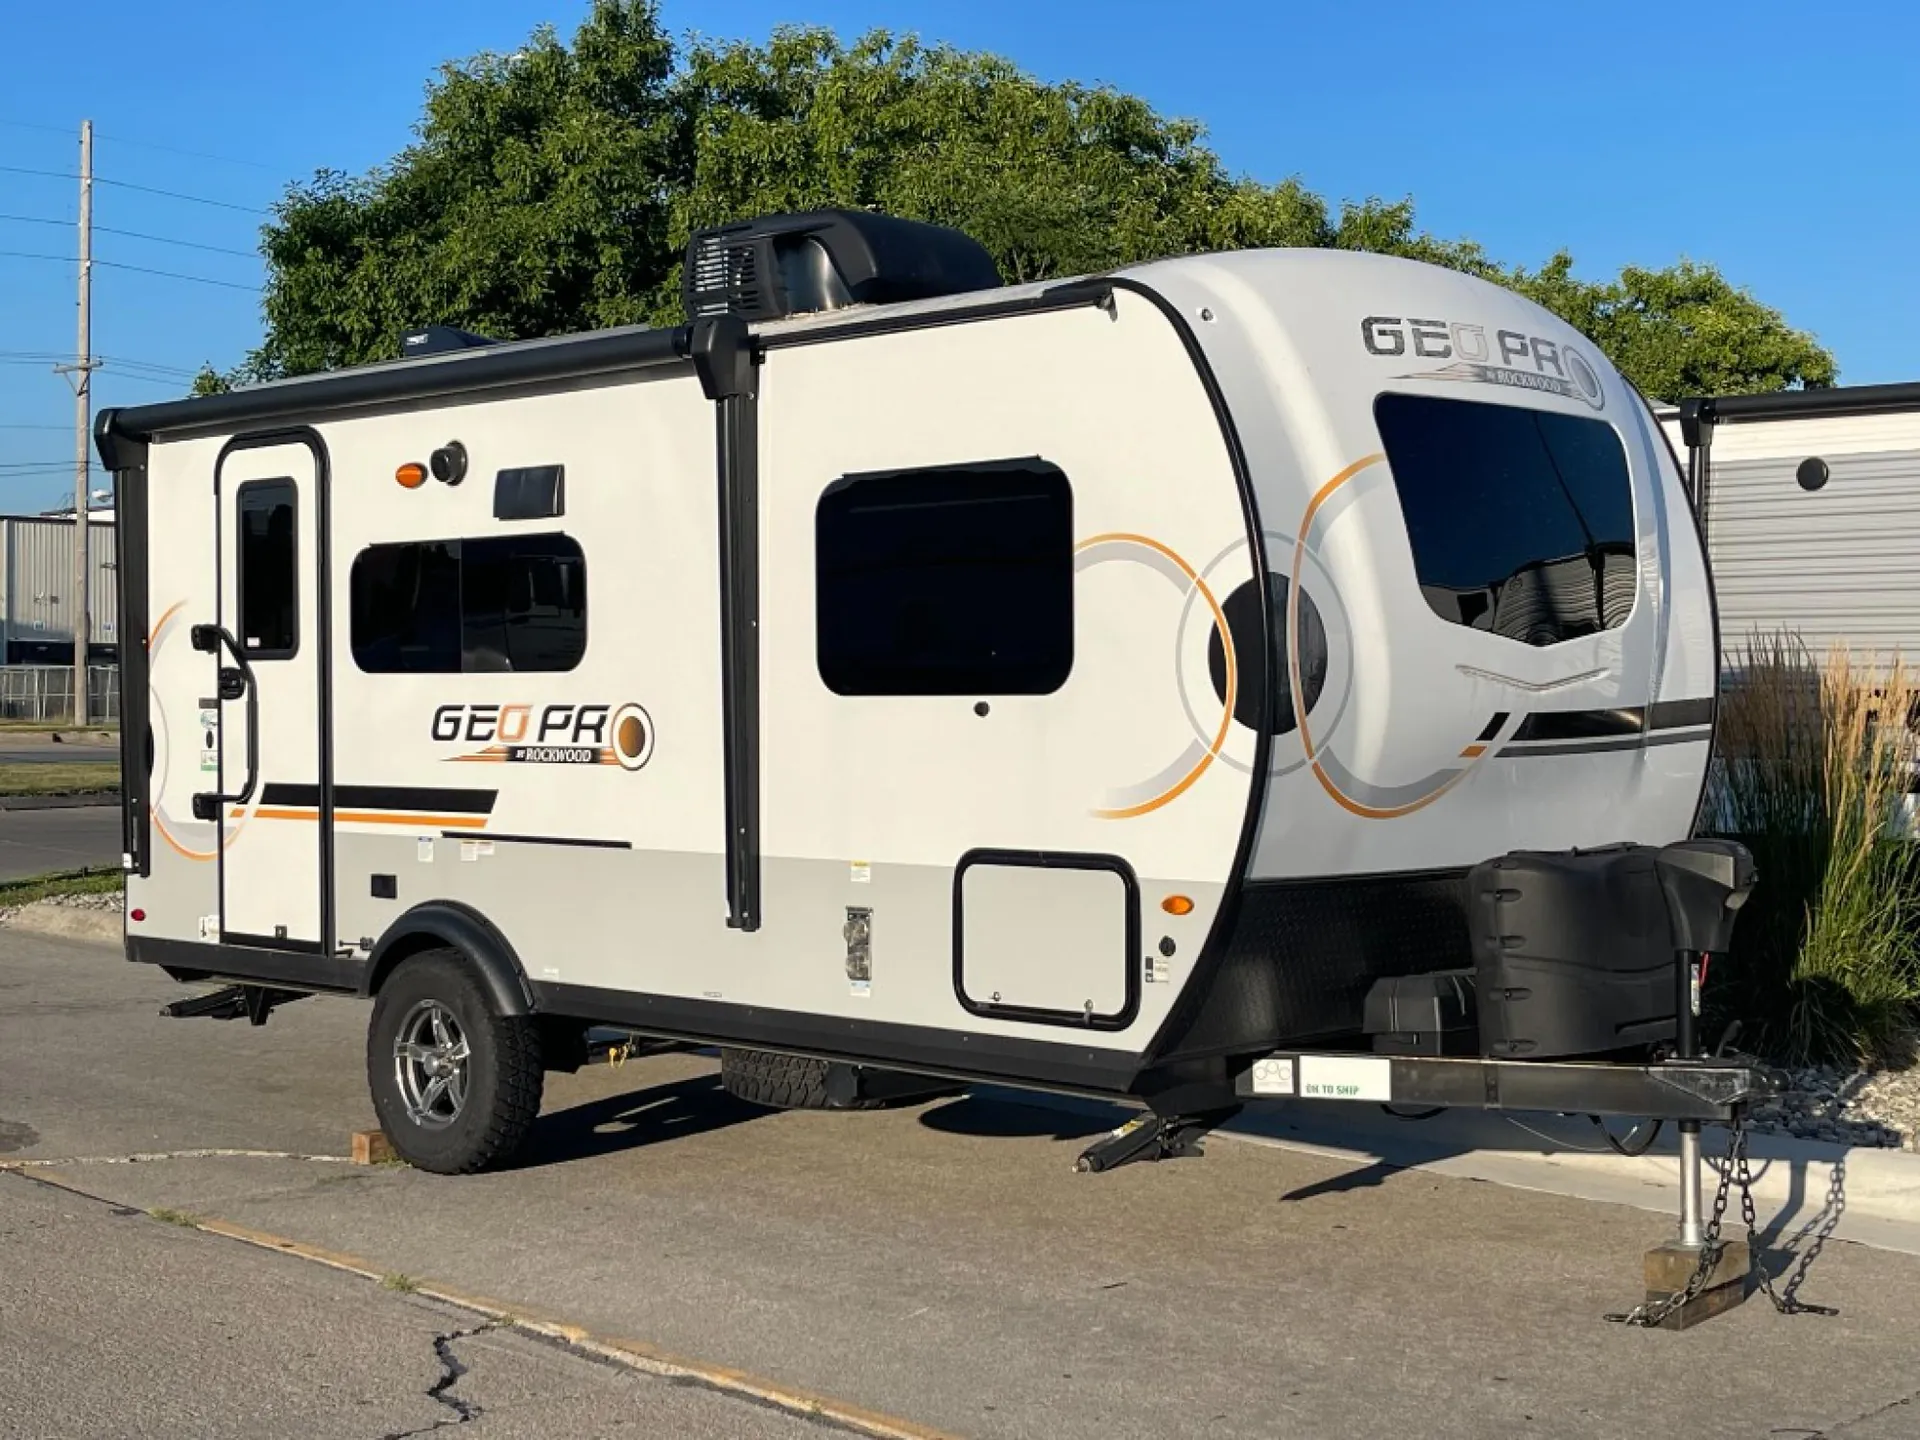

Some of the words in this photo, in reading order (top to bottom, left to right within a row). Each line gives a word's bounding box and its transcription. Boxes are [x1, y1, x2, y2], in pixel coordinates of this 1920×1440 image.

[1360, 315, 1490, 363] GEO
[431, 703, 534, 743] GEO
[526, 747, 592, 762] ROCKWOOD
[1322, 1083, 1335, 1095] TO
